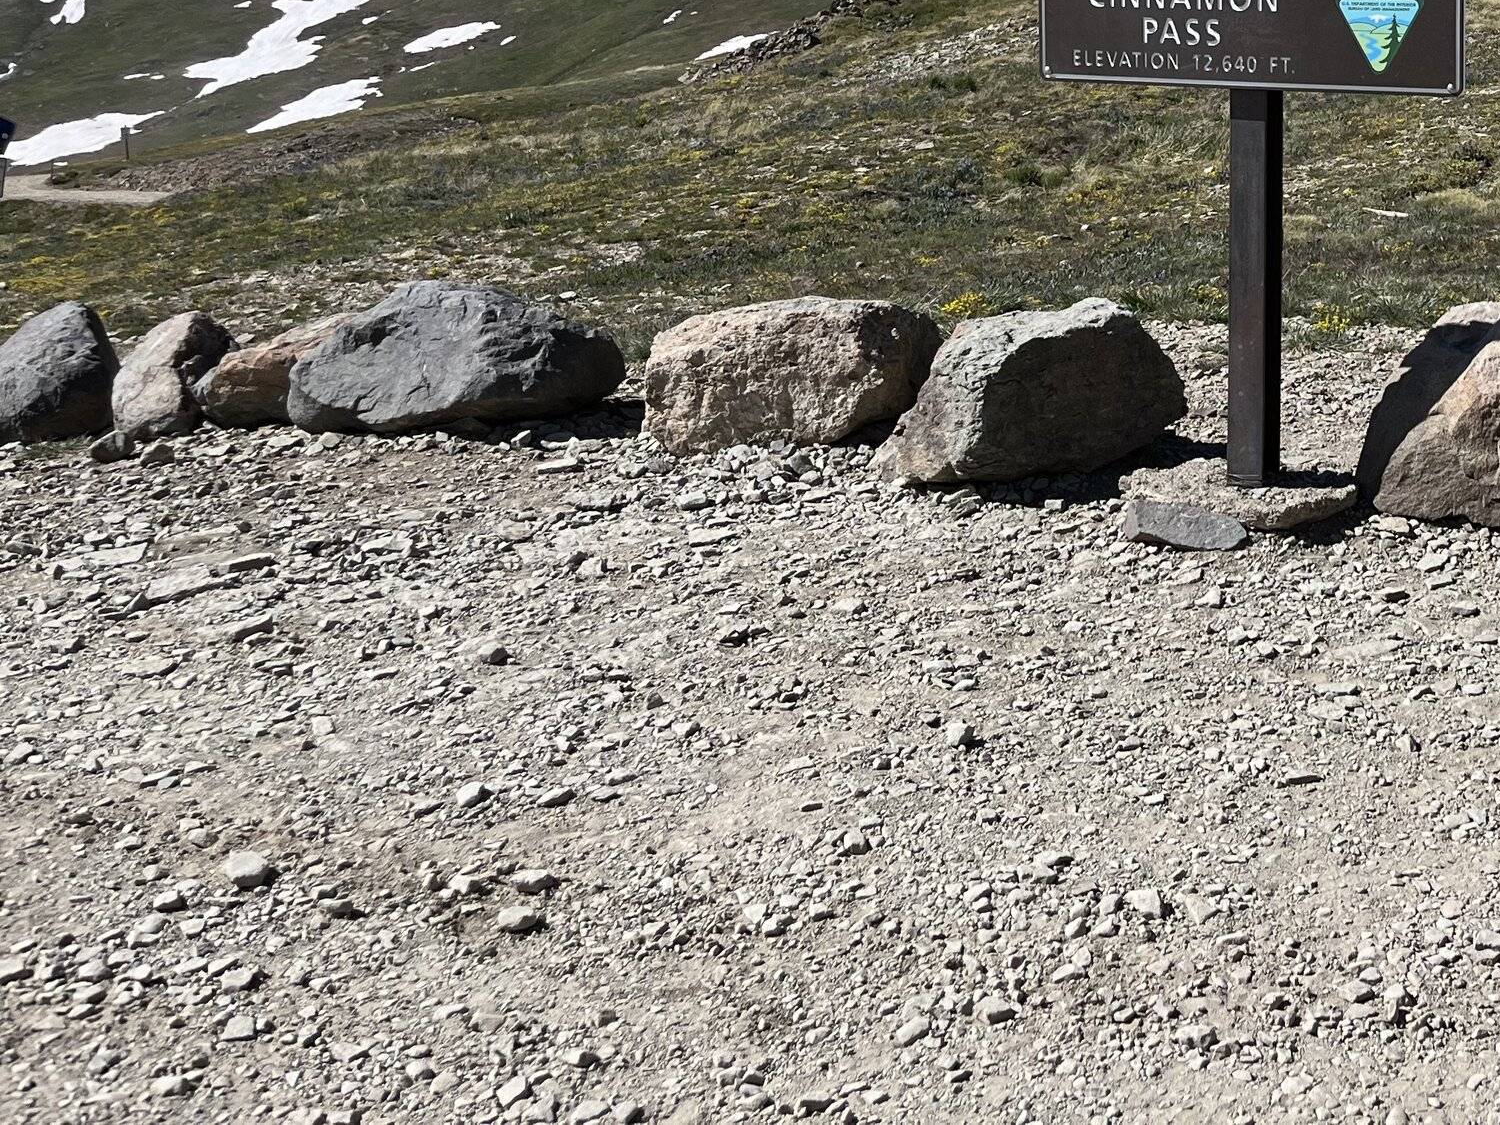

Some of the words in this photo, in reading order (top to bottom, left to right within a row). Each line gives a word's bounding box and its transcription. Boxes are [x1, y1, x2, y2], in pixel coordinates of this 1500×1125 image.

[1142, 17, 1221, 47] PASS
[1073, 49, 1179, 70] ELEVATION
[1193, 54, 1257, 73] 12,640
[1269, 57, 1295, 74] FT.
